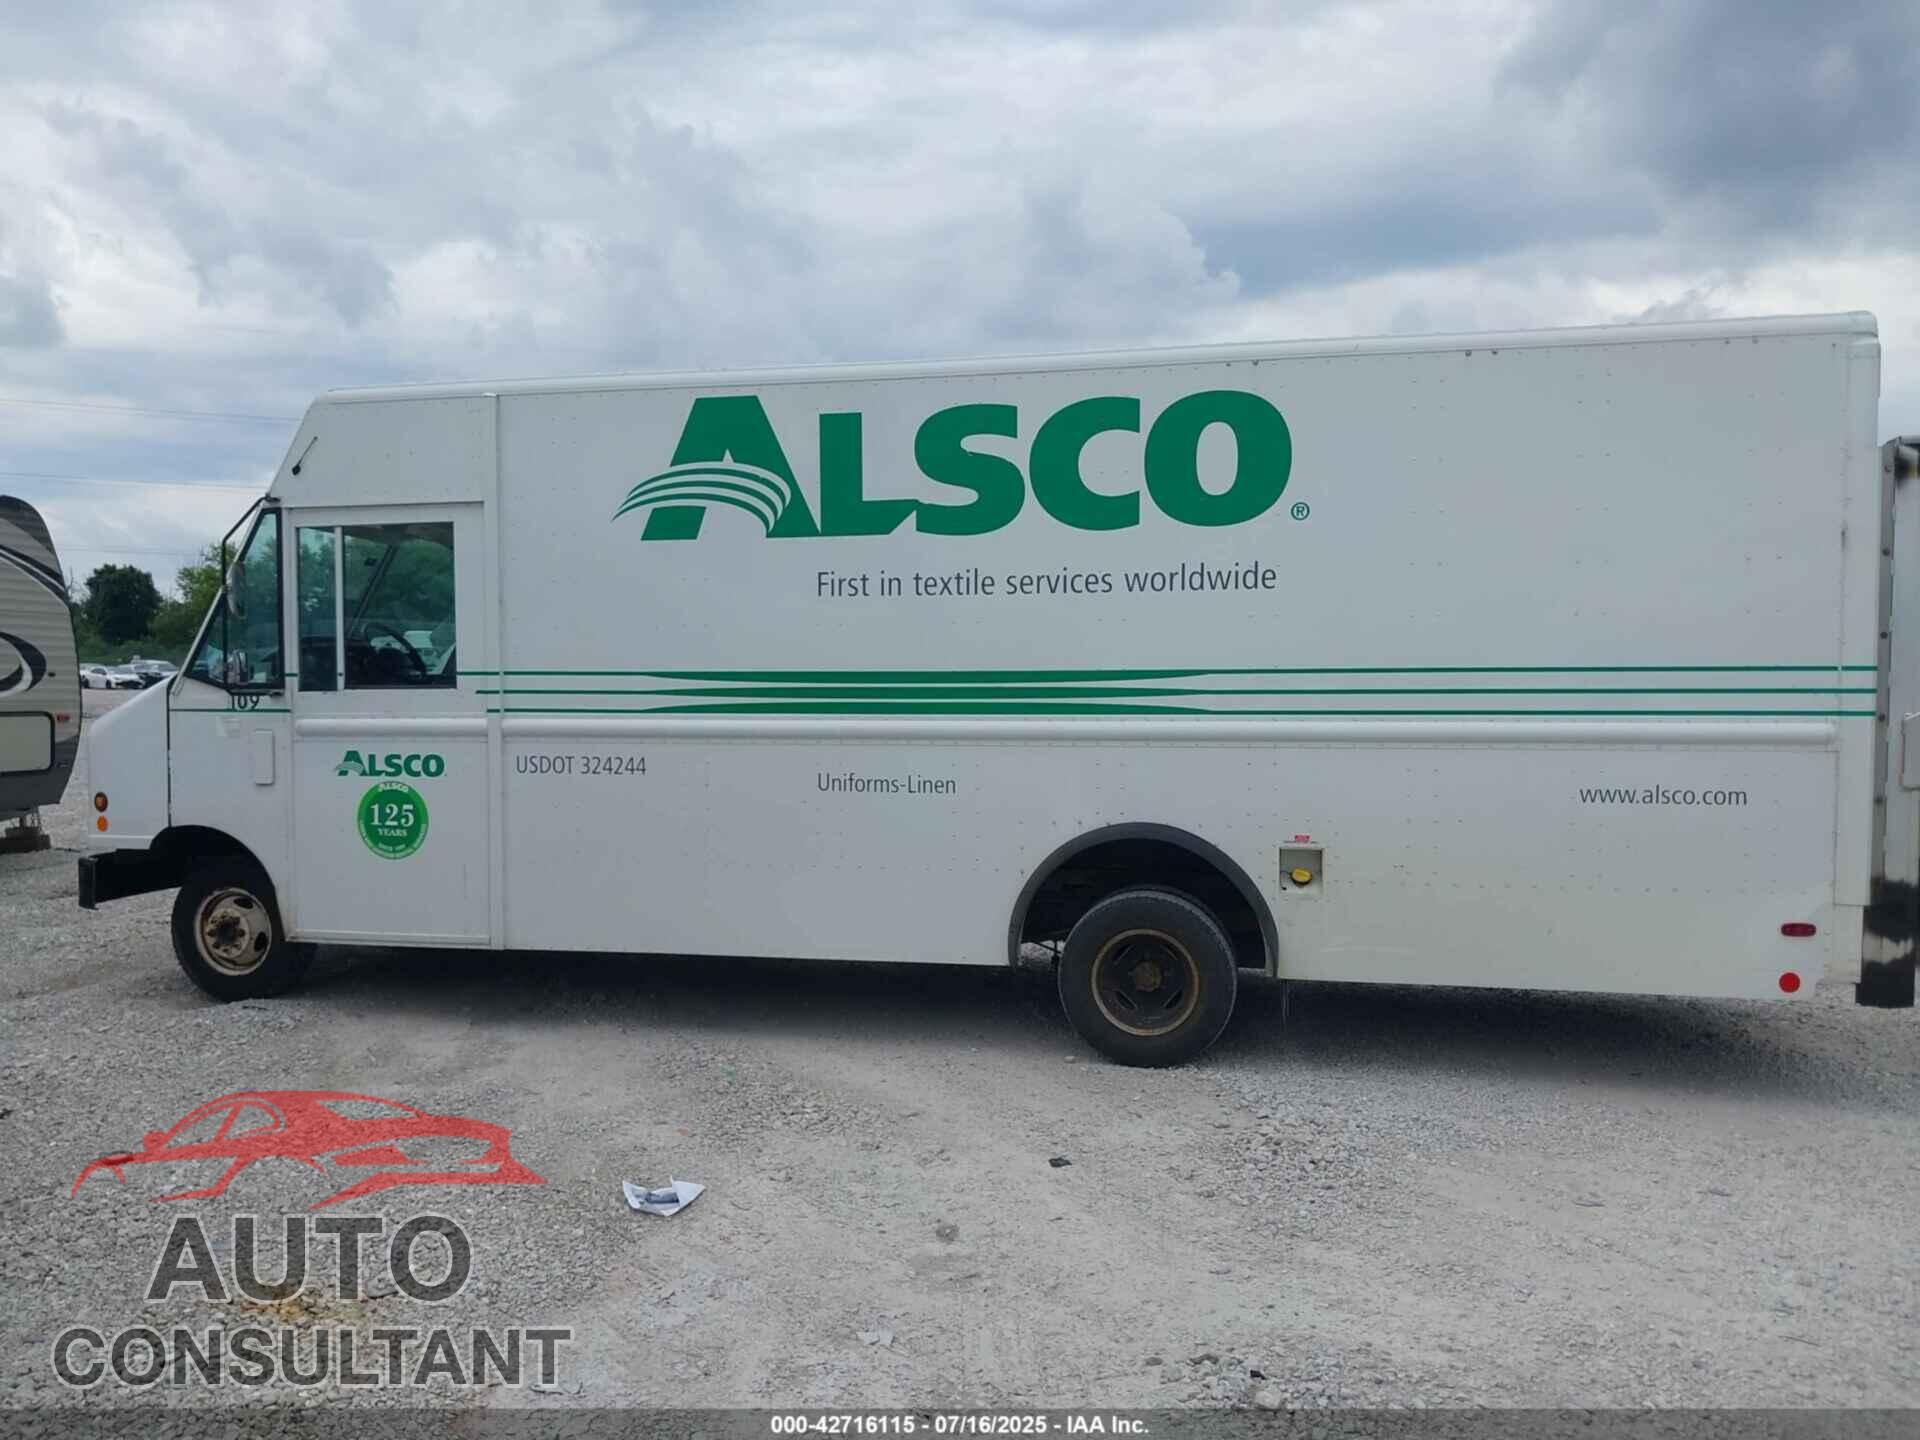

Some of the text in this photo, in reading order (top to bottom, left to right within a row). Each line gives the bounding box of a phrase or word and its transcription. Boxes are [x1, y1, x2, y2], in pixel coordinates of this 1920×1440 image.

[612, 390, 1292, 541] ALSCO
[816, 562, 1277, 597] First in textile services worldwide
[336, 750, 445, 777] ALSCO
[516, 755, 646, 775] USDOT 324244
[817, 772, 957, 794] Uniforms-Linen
[1579, 784, 1748, 806] www.alsco.com
[370, 803, 415, 827] 125
